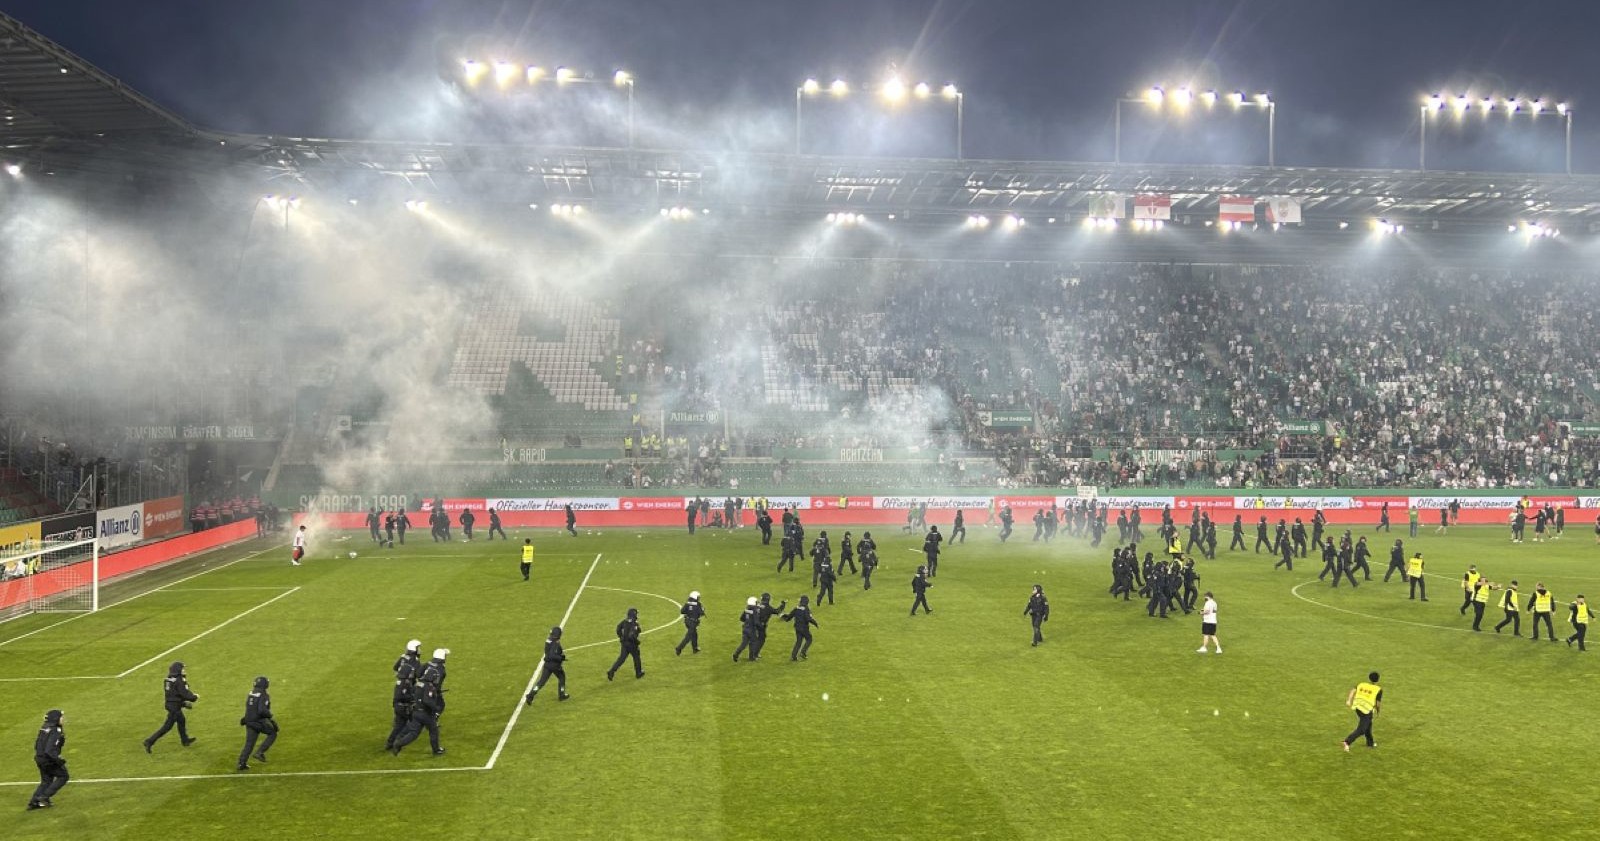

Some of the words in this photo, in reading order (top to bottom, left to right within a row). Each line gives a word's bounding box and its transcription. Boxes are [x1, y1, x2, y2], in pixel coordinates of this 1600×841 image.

[670, 411, 706, 422] Allianz
[519, 448, 546, 462] RAPID
[100, 517, 130, 538] Allianz
